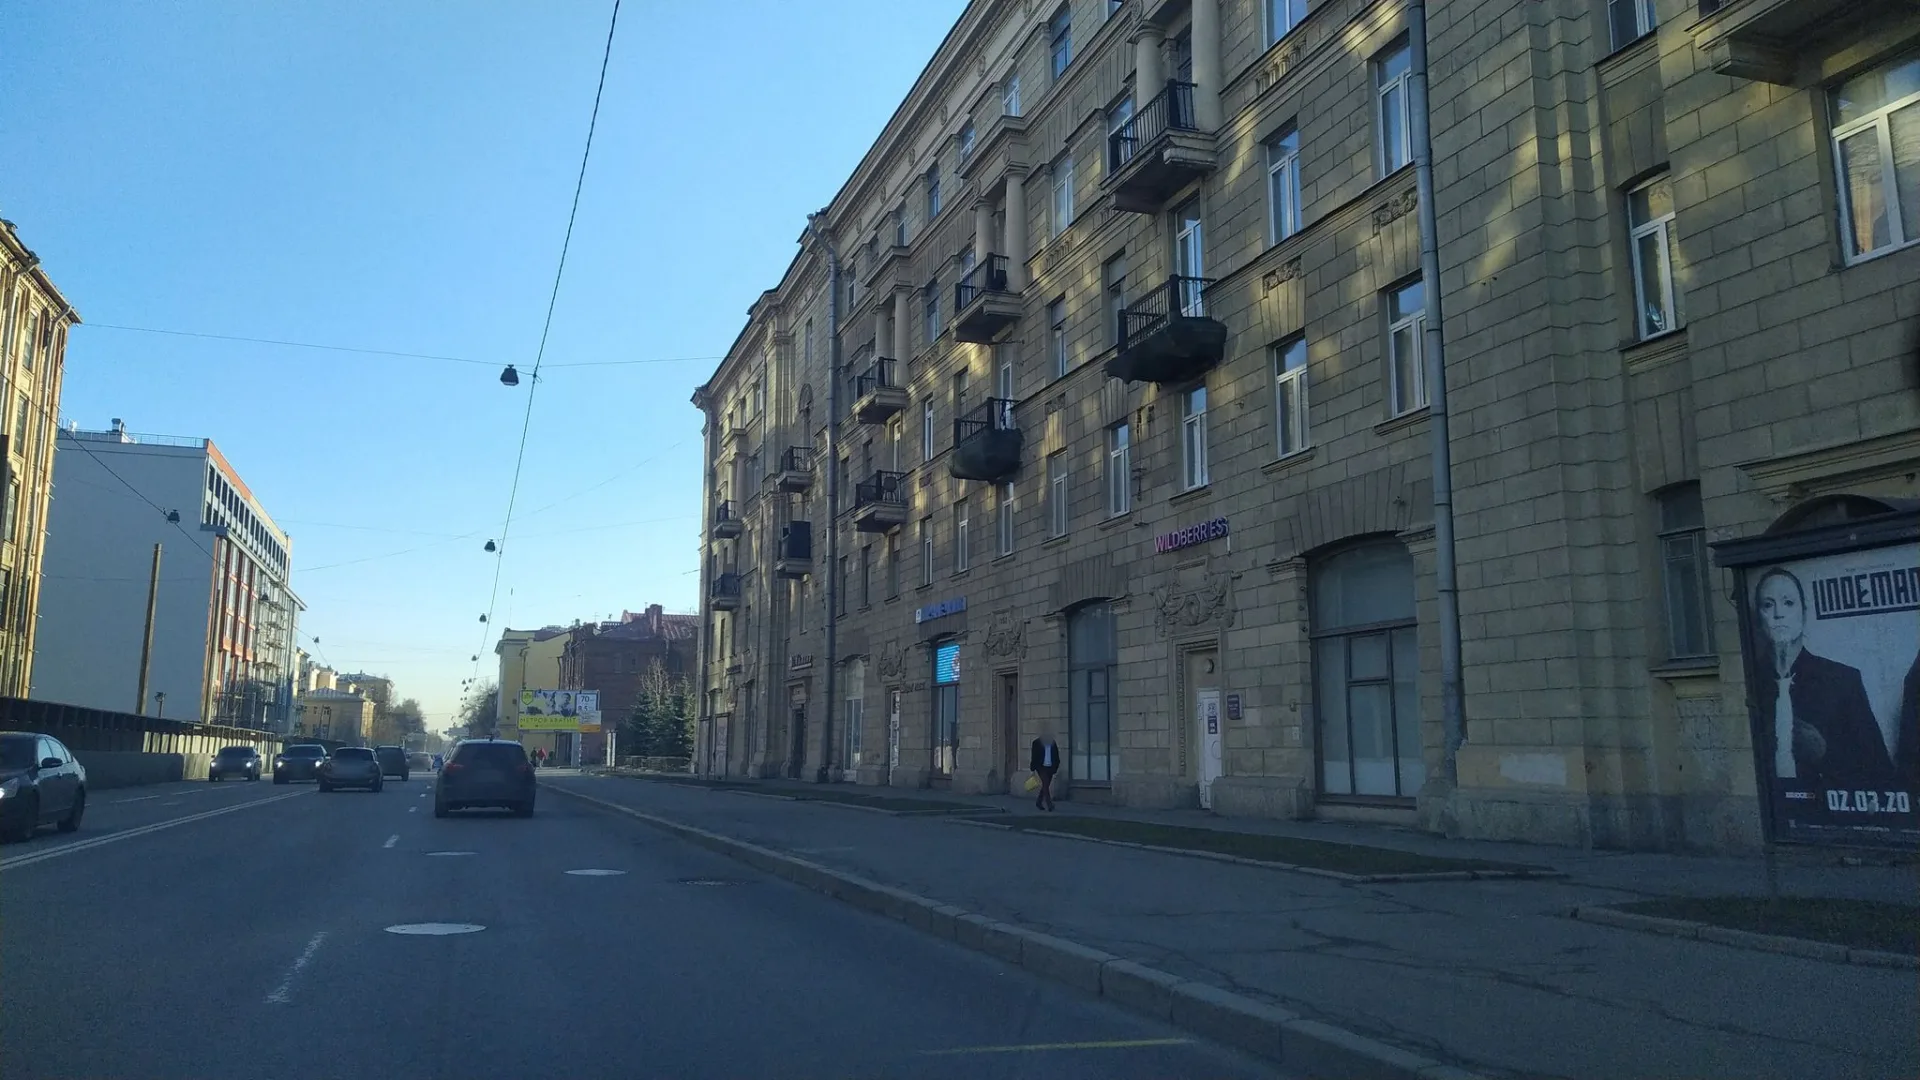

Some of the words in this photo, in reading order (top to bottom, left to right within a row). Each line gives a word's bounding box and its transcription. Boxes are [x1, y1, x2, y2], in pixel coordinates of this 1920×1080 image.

[1154, 516, 1229, 552] WILDBERRIES
[581, 695, 590, 703] 70
[1826, 790, 1911, 813] 02.03.20
